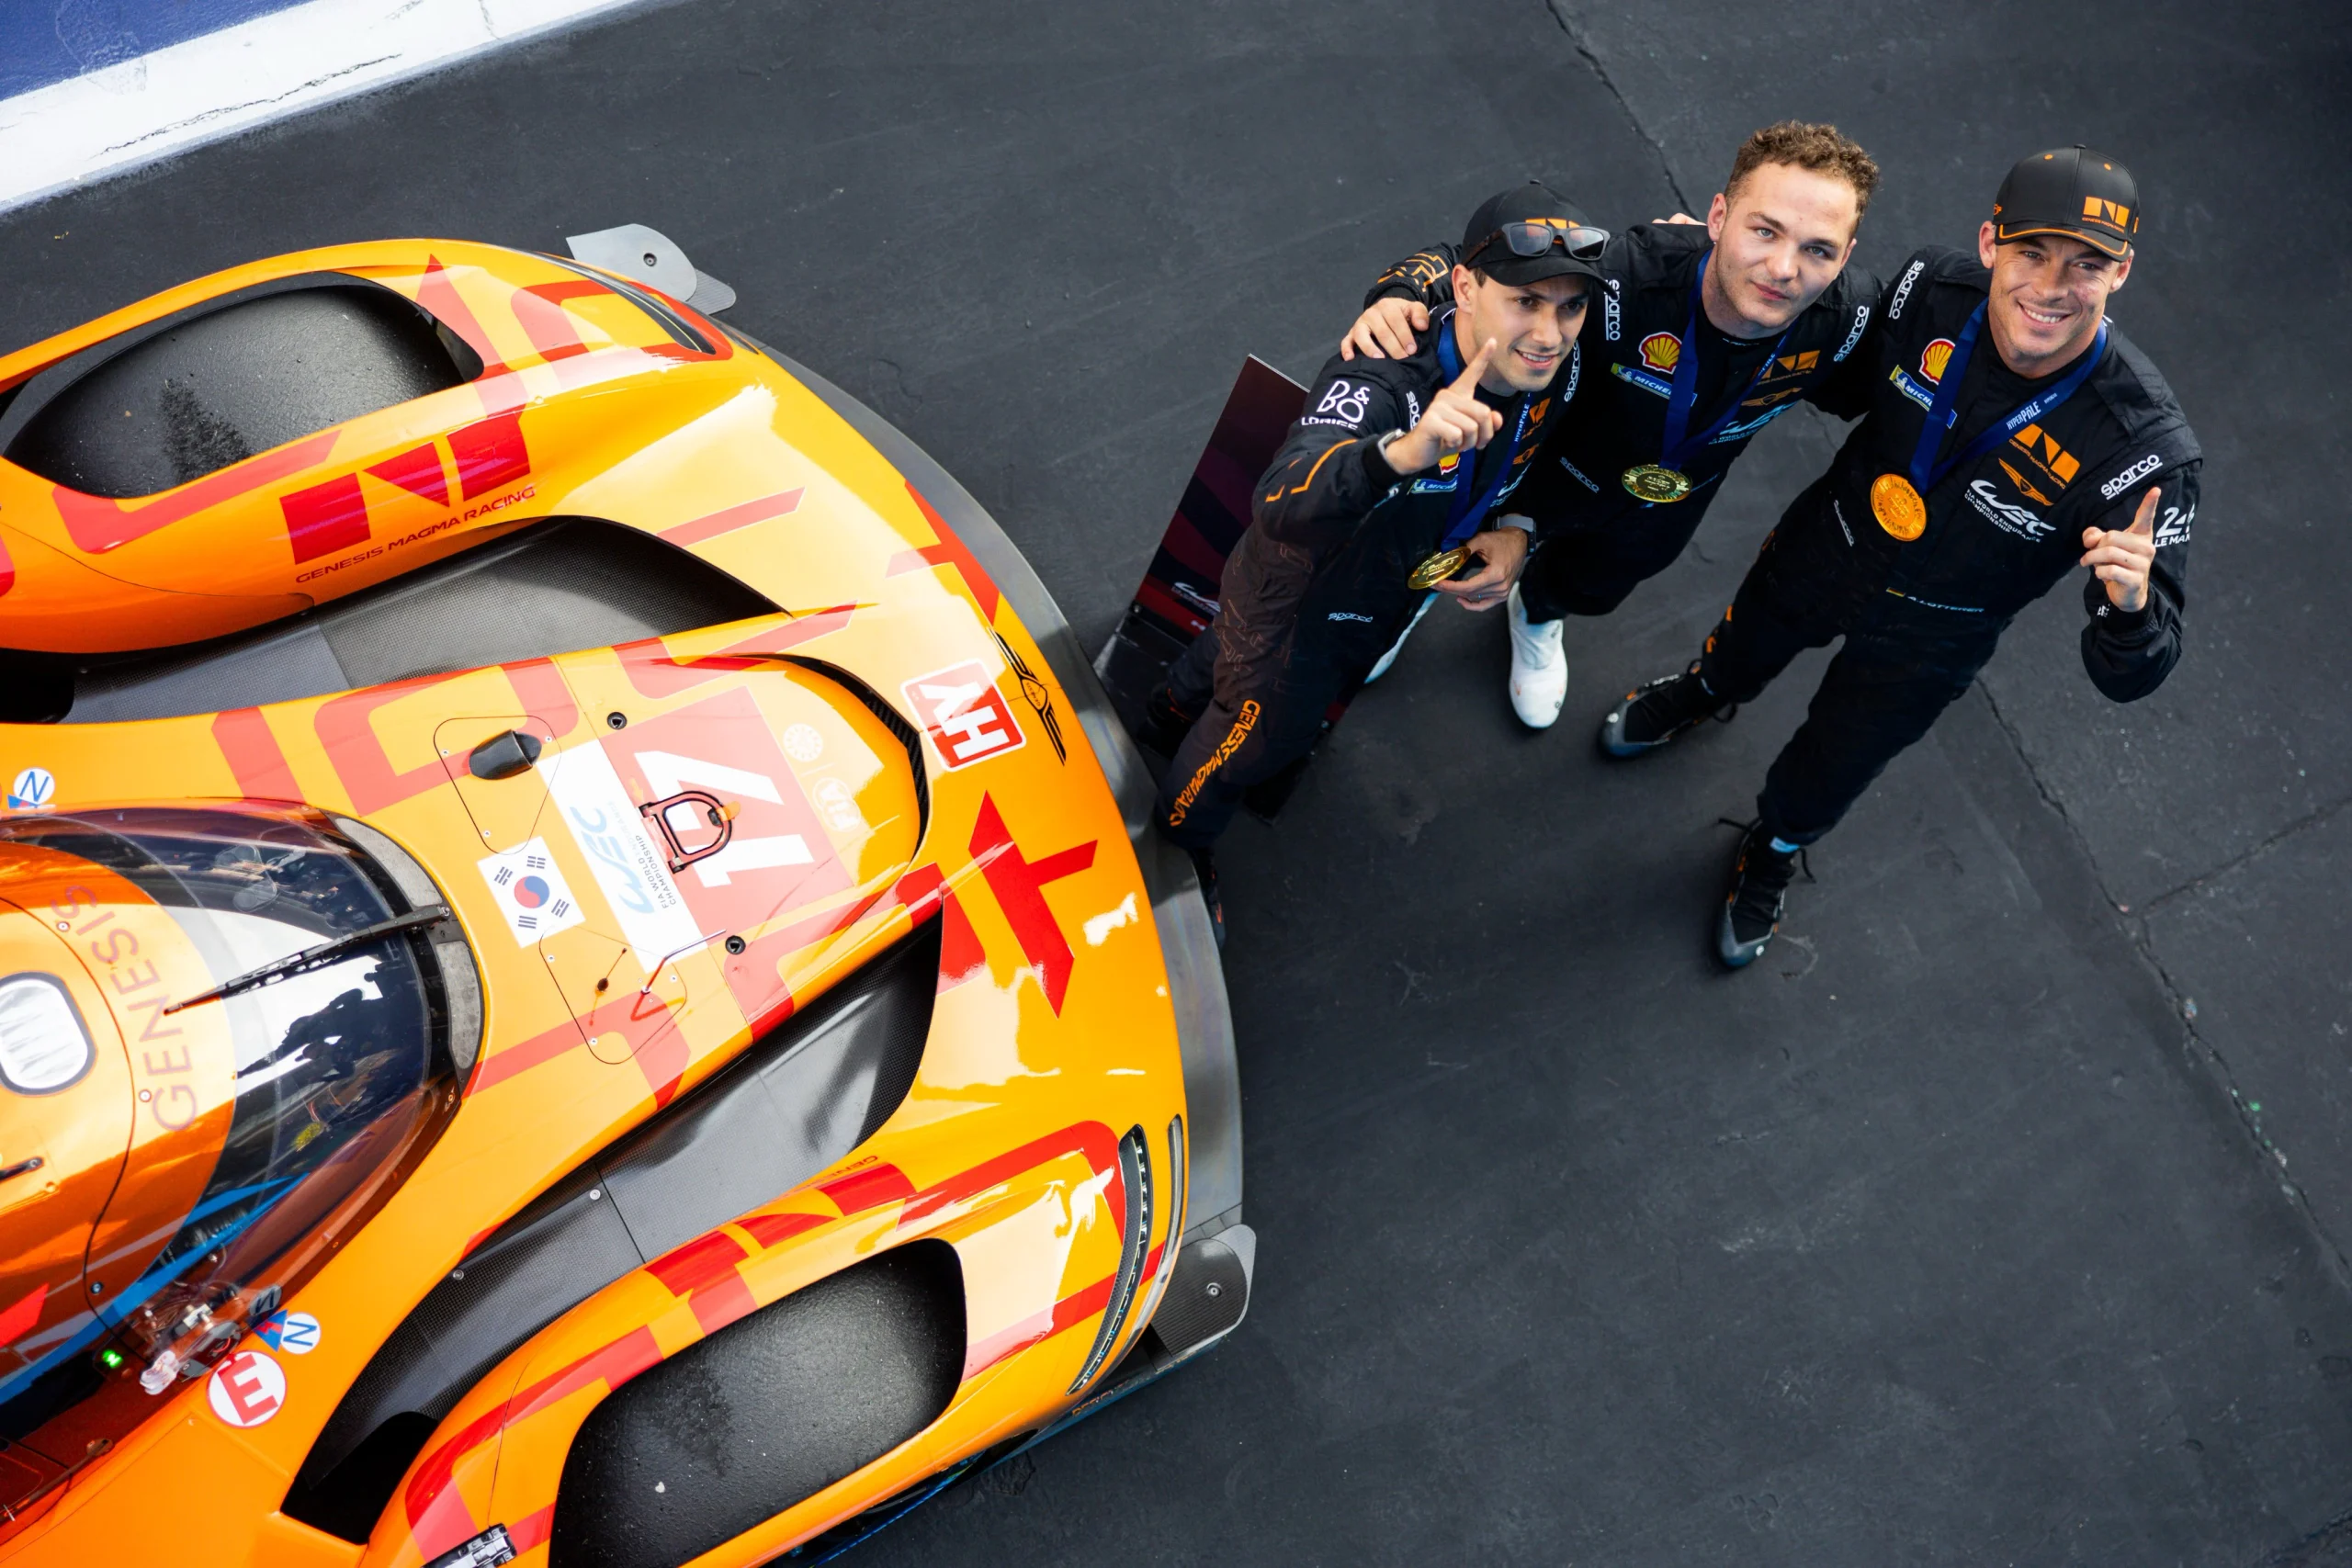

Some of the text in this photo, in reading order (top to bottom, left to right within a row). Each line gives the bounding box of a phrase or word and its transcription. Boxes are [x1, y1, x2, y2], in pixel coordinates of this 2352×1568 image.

[1888, 260, 1925, 320] sparco
[1834, 305, 1870, 362] sparco
[1634, 376, 1672, 395] MICHE
[1905, 385, 1933, 407] MICH
[1406, 391, 1421, 432] spa
[1427, 480, 1458, 490] MICH
[1559, 457, 1600, 494] sparco
[2101, 454, 2163, 501] sparco
[1964, 493, 2012, 534] CHAMPIONSHIP
[1974, 498, 1999, 520] WORLD
[1998, 517, 2041, 543] ENDURANCE
[295, 485, 536, 584] GENESIS MAGMA RACING
[2154, 533, 2191, 547] LE MAN
[1328, 612, 1374, 623] sparco
[919, 681, 1010, 761] HY
[18, 771, 50, 802] N
[634, 750, 816, 888] 17
[635, 834, 676, 907] CHAMPIONSHIP
[638, 858, 660, 891] WORLD
[656, 893, 670, 909] FIA
[50, 885, 198, 1132] GENESIS
[283, 1320, 318, 1348] N
[217, 1353, 279, 1426] E
